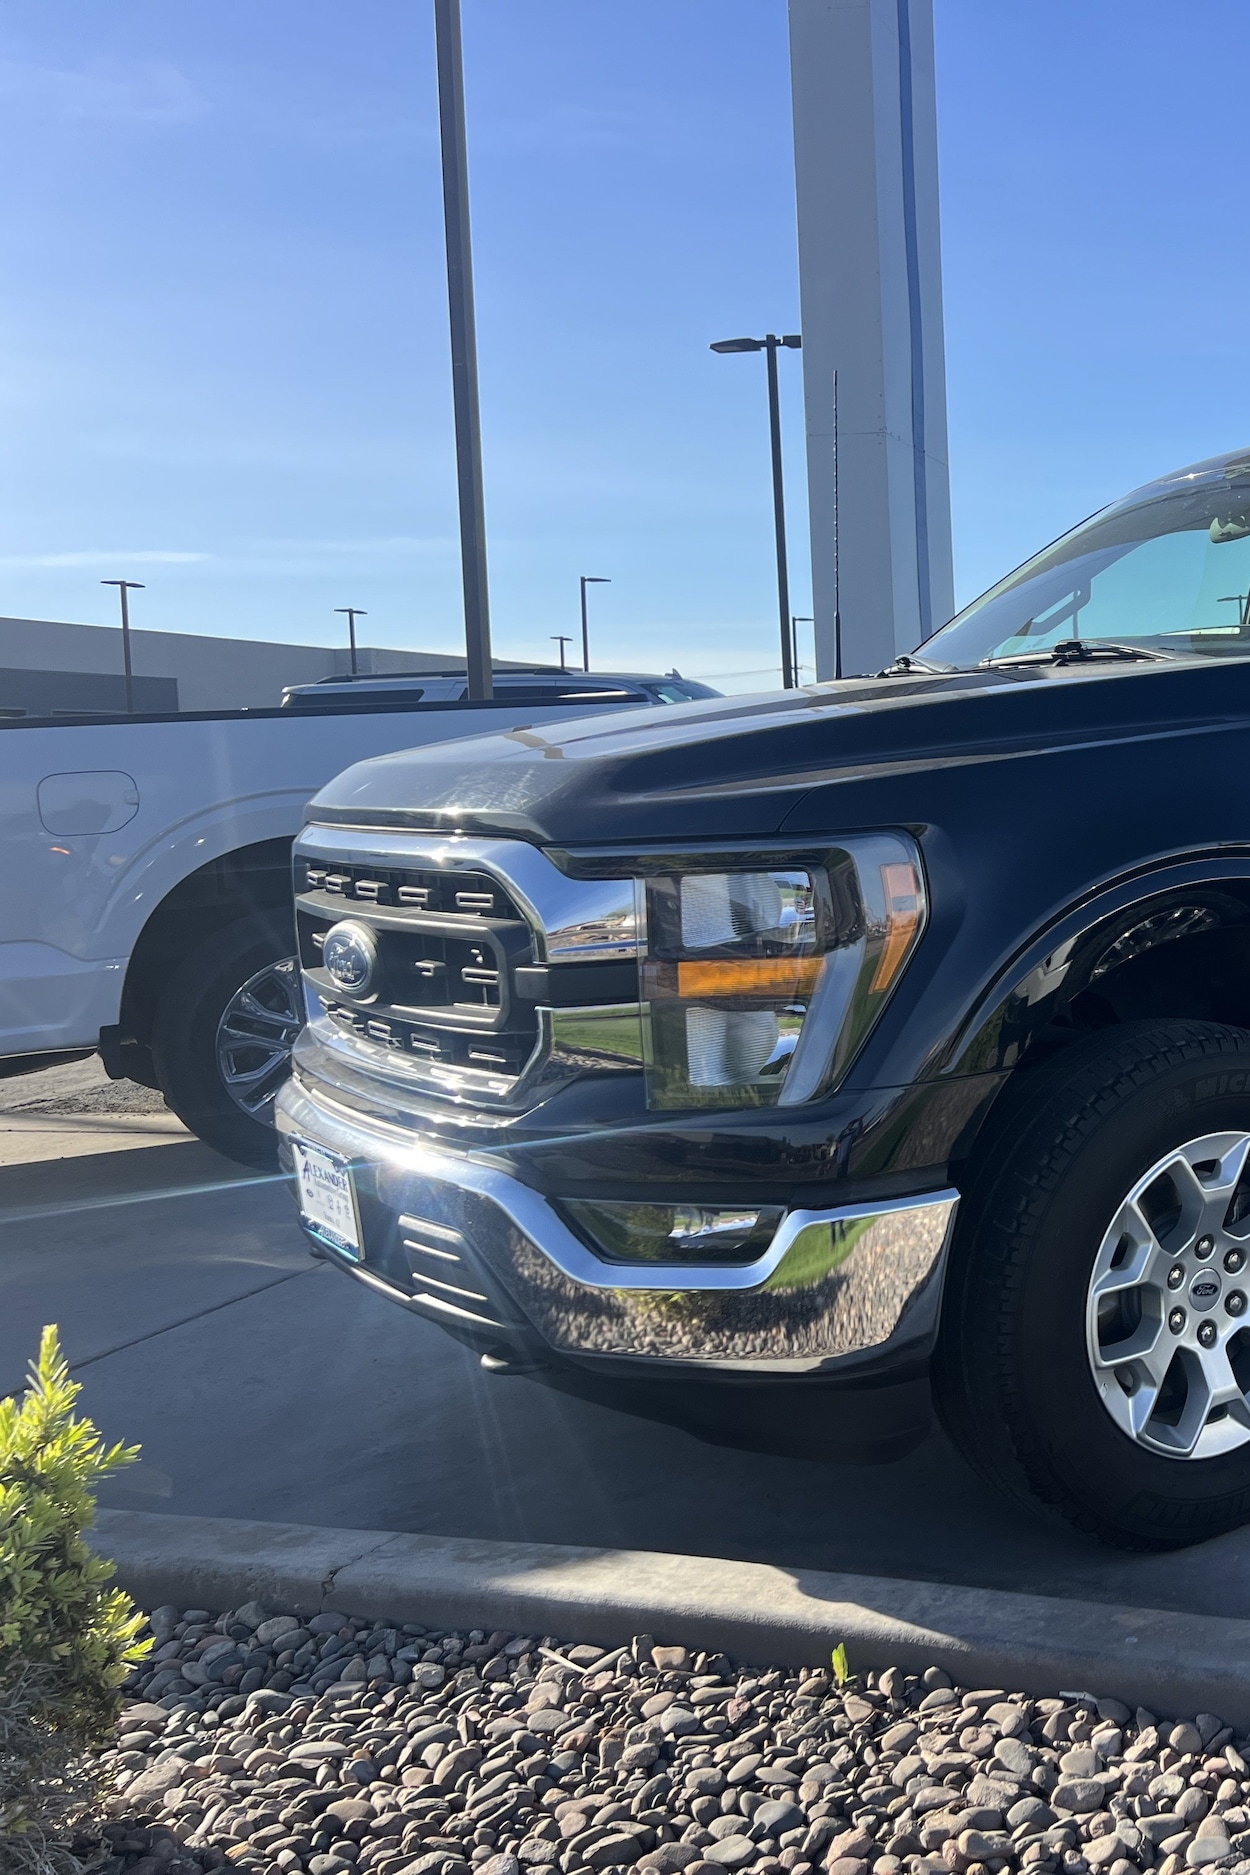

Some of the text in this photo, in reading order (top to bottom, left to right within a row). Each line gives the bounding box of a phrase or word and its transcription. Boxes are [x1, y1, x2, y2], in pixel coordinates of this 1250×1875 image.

[328, 943, 361, 980] Ford
[303, 1159, 348, 1192] ALEXANDER
[1197, 1284, 1215, 1295] Ford
